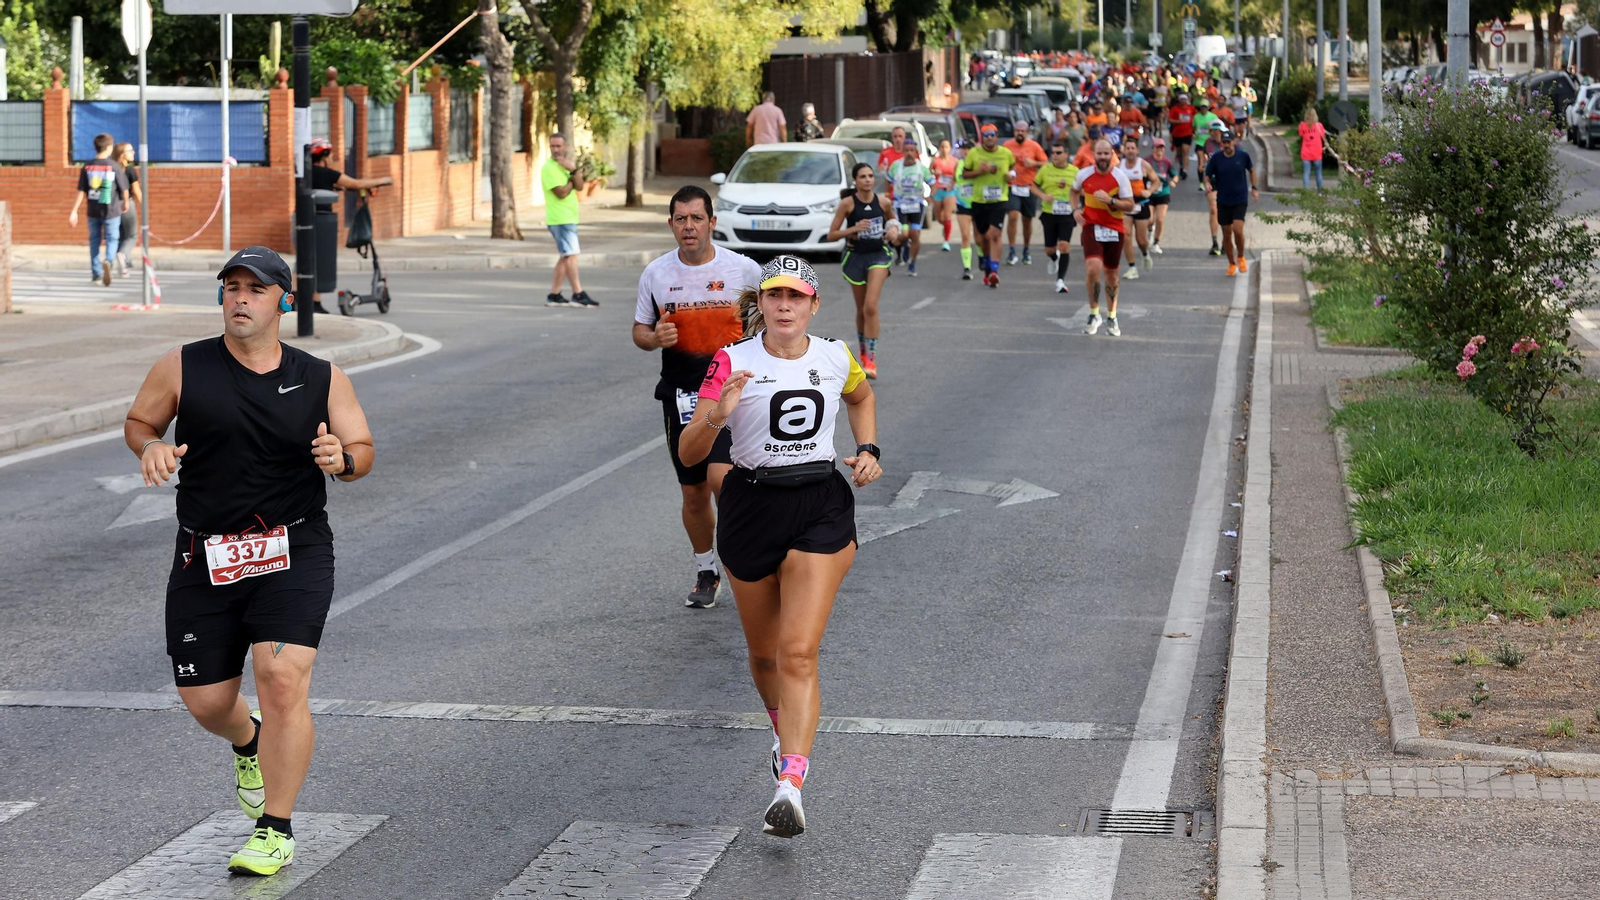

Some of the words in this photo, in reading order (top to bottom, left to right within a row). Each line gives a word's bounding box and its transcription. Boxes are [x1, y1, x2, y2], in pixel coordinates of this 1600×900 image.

[677, 300, 732, 308] RUBYSAN
[764, 442, 817, 453] asodena
[226, 540, 268, 564] 337
